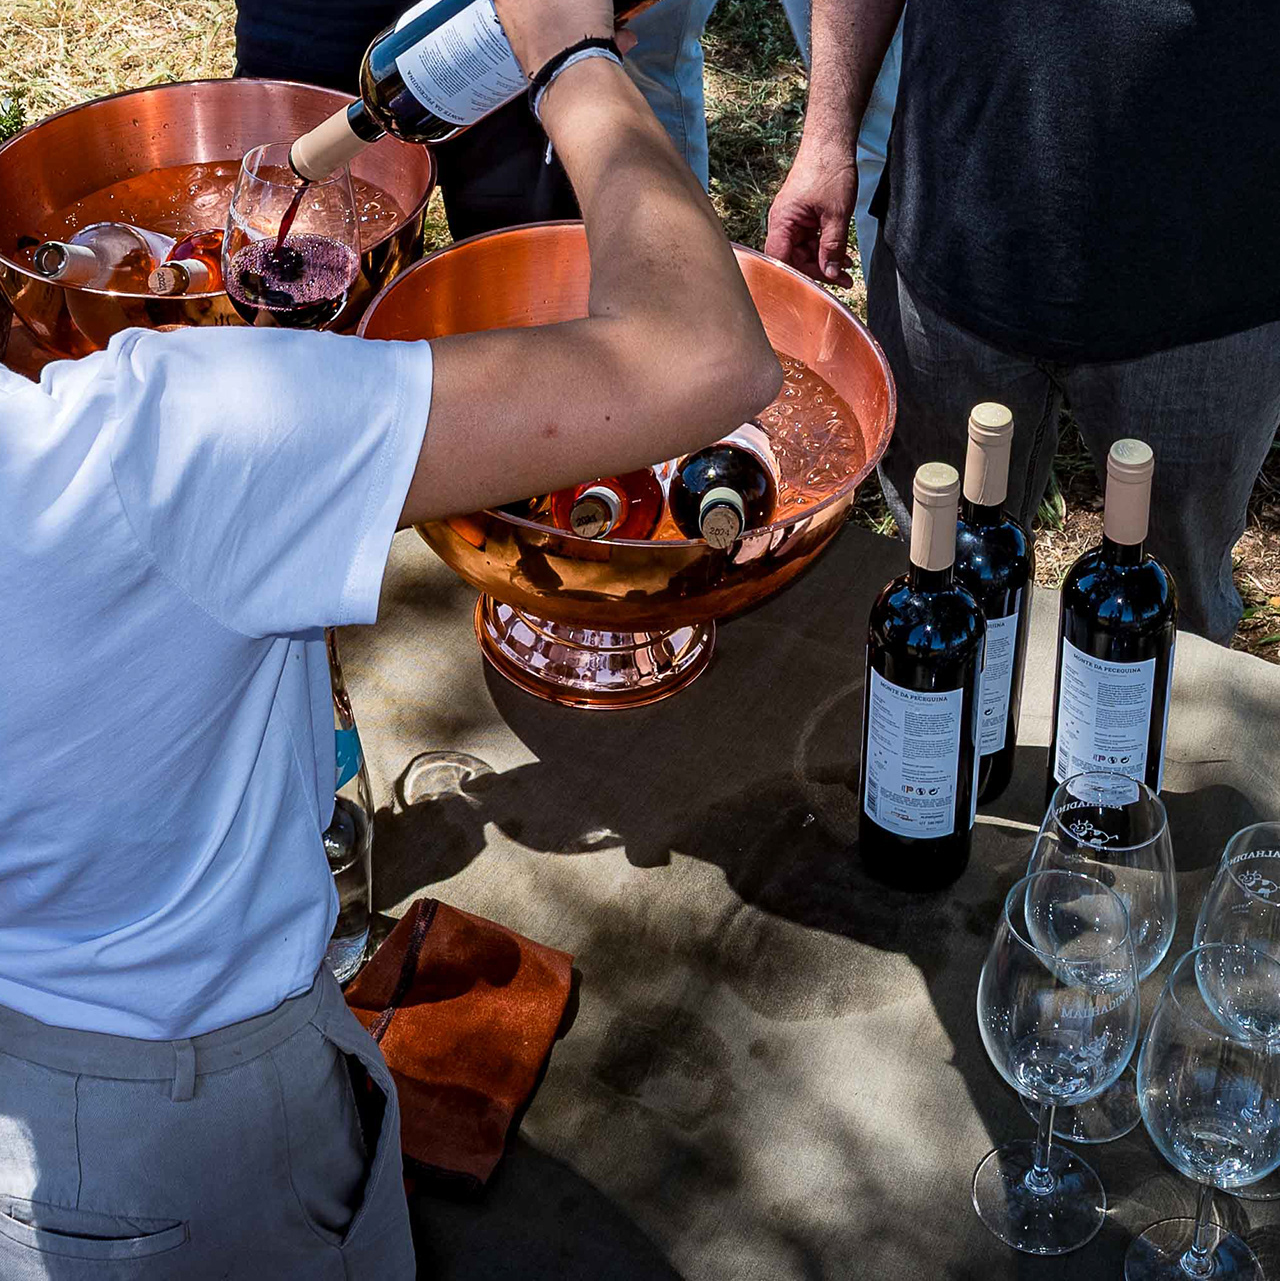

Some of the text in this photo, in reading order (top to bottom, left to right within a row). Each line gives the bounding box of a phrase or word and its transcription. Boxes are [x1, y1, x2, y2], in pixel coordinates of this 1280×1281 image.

[1074, 653, 1093, 668] MONTE
[1104, 666, 1141, 674] PECEGUINA
[880, 681, 899, 695] MONTE
[909, 694, 948, 703] PECEGUINA
